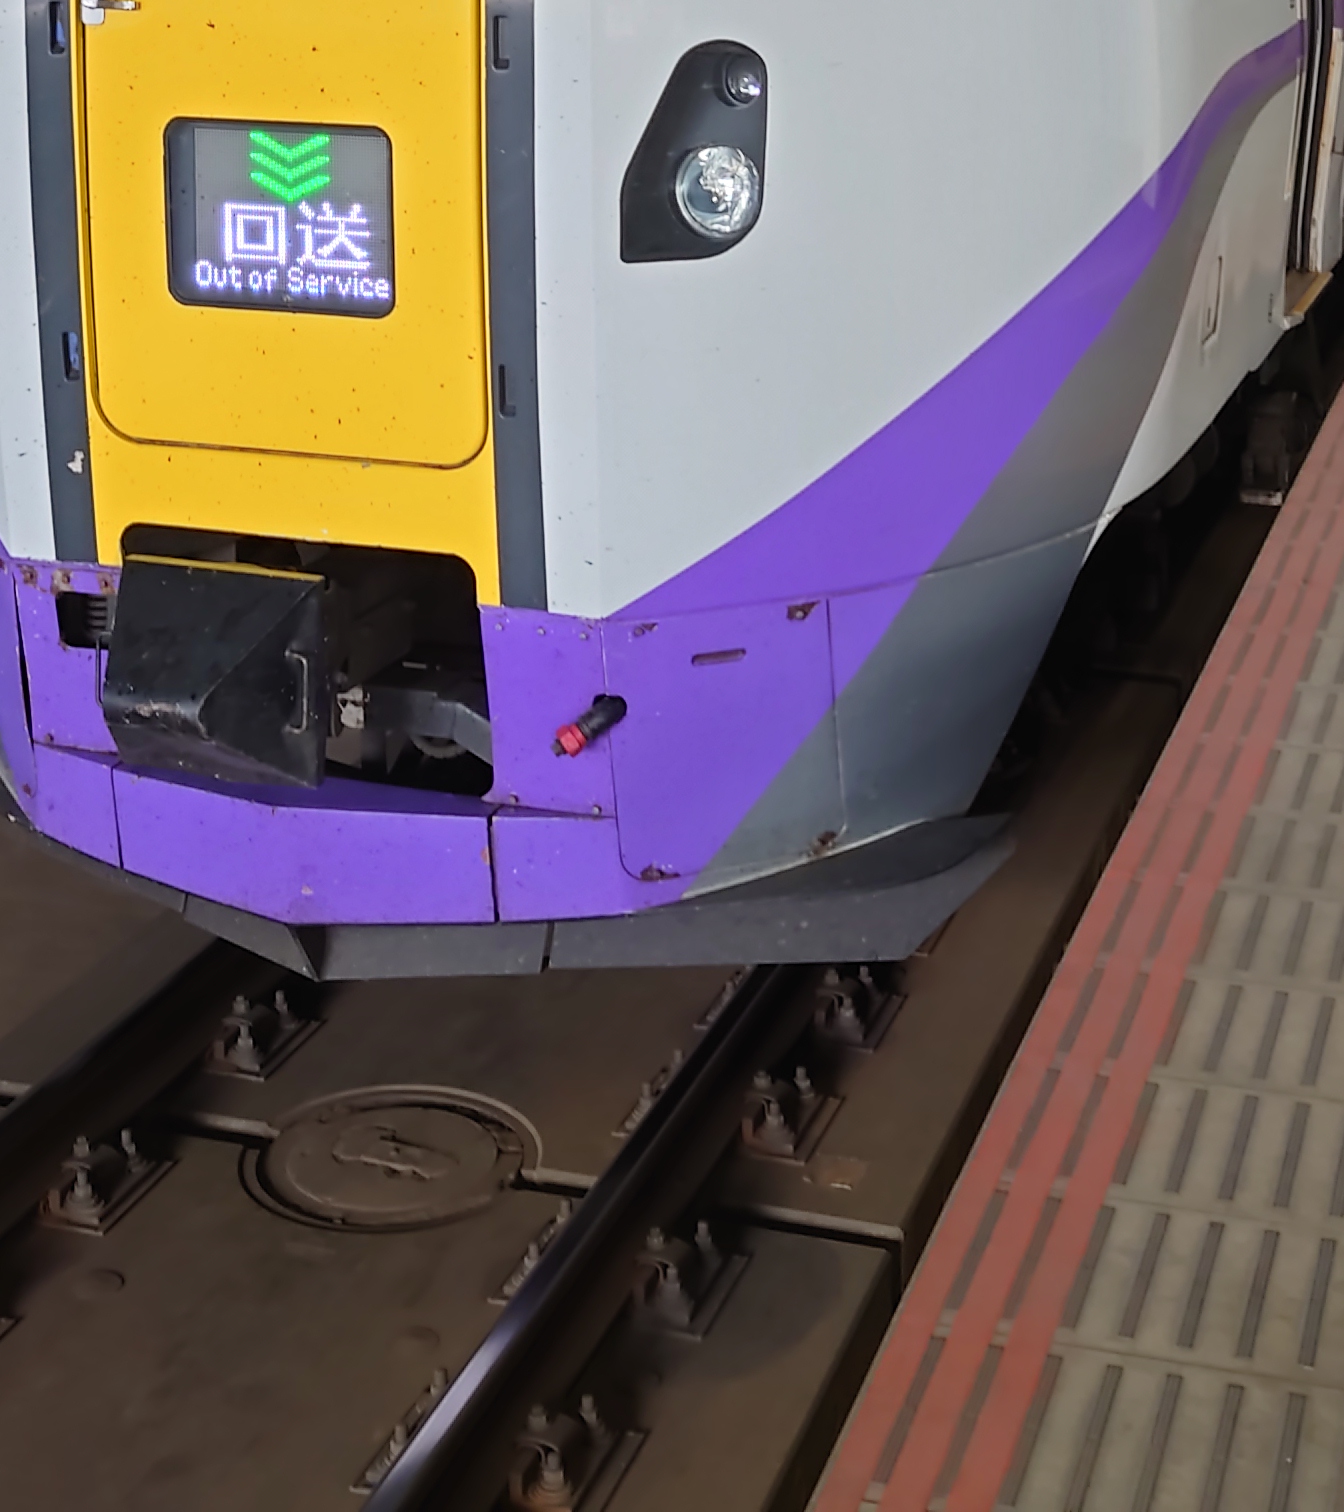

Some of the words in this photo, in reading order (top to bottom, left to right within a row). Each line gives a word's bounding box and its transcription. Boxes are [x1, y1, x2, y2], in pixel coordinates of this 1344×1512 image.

[223, 201, 372, 270] 回送
[194, 259, 242, 290] Out
[249, 267, 279, 294] of
[286, 266, 391, 300] Service
